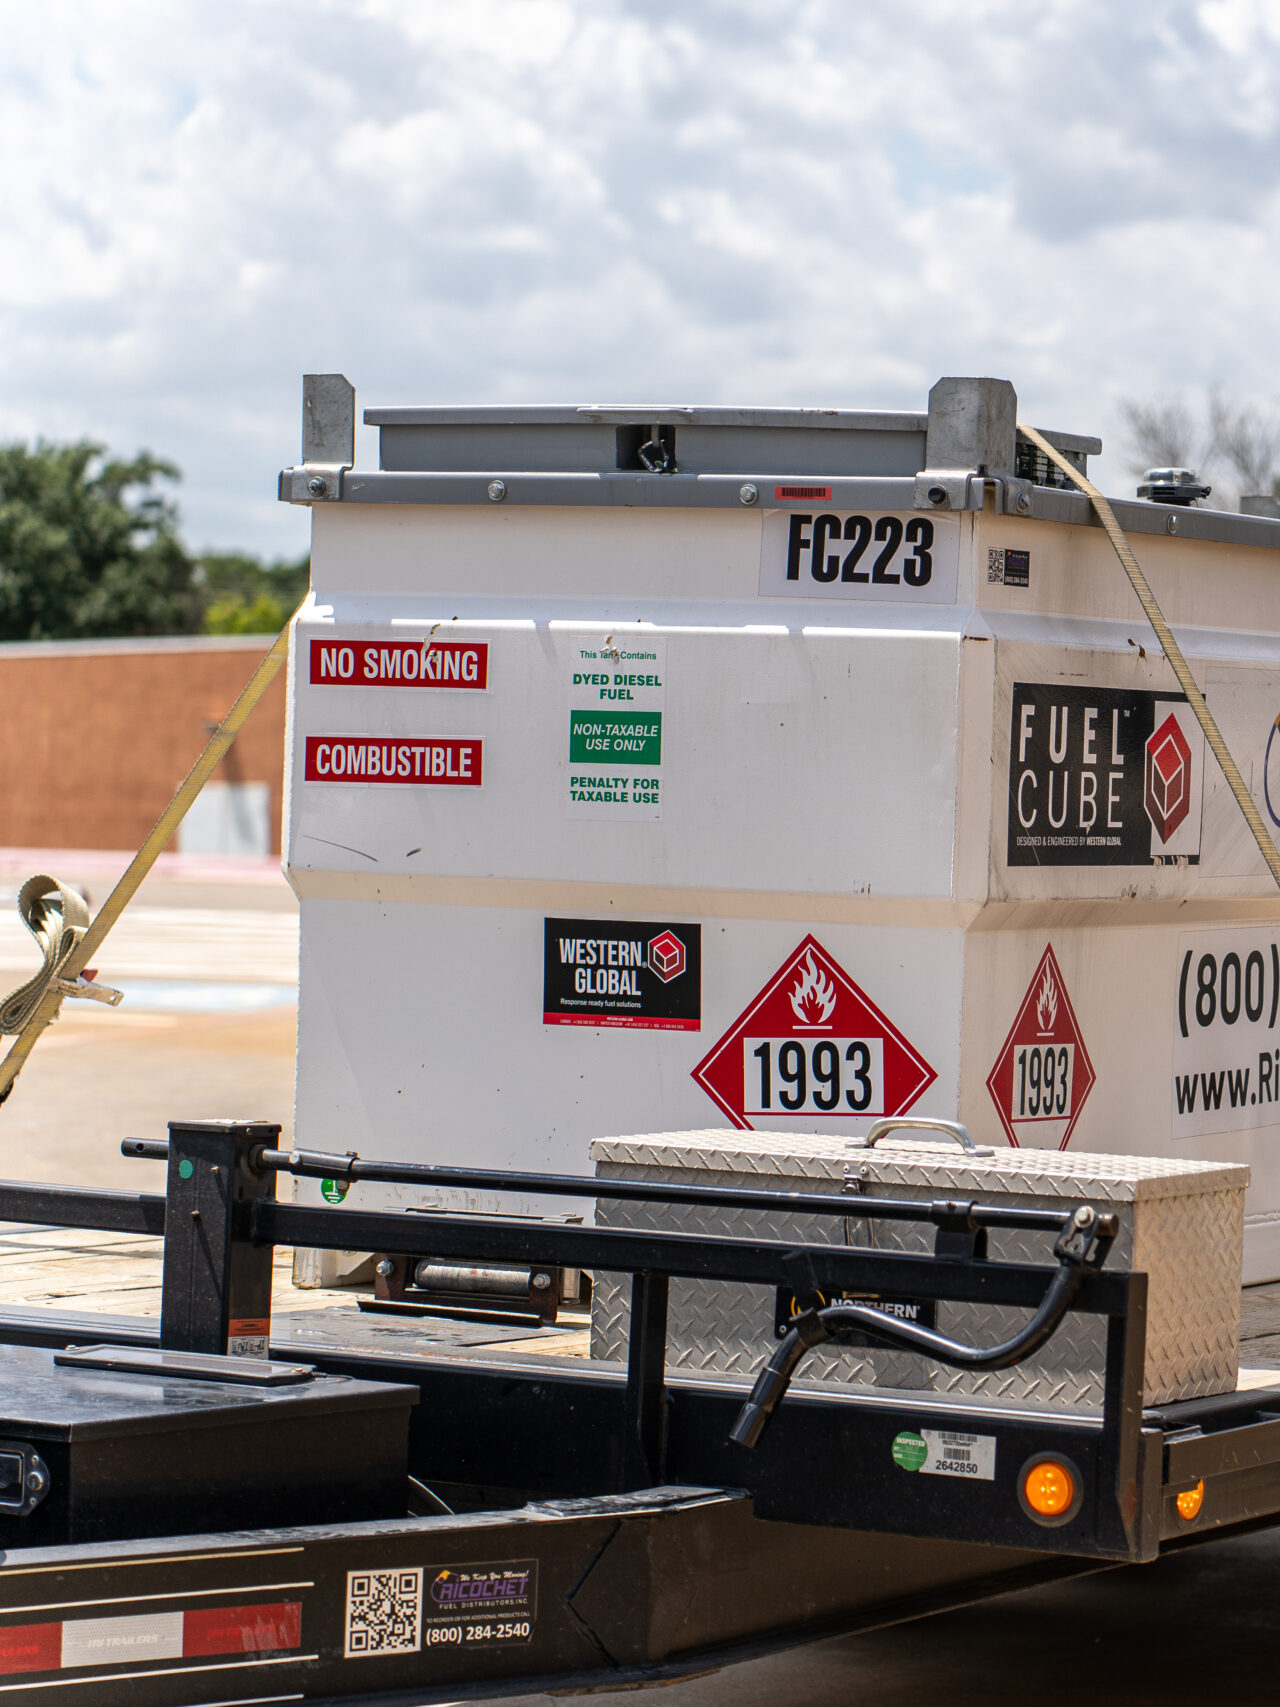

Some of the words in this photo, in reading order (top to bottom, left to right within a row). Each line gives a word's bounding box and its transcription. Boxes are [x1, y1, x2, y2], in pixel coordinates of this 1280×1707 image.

[786, 514, 934, 587] FC223
[320, 647, 355, 678] NO
[363, 648, 479, 681] SMOKING
[580, 650, 597, 659] This
[600, 650, 619, 660] Tan
[620, 651, 657, 660] Contains
[573, 673, 610, 685] DYED
[614, 674, 662, 687] DIESEL
[600, 688, 634, 700] FUEL
[573, 723, 659, 737] NON-TAXABLE
[1018, 704, 1125, 765] FUEL
[585, 738, 611, 750] USE
[613, 739, 646, 751] ONLY
[316, 744, 473, 778] COMBUSTIBLE
[570, 776, 629, 789] PENALTY
[632, 778, 660, 790] FOR
[569, 790, 629, 803] TAXABLE
[632, 792, 660, 804] USE
[1017, 769, 1124, 828] CUBE
[1016, 836, 1042, 846] DESIGNED
[559, 938, 642, 966] WESTERN
[574, 968, 642, 996] GLOBAL
[1178, 943, 1280, 1038] (800)
[561, 998, 587, 1007] Response
[588, 1000, 604, 1008] ready
[604, 1000, 616, 1008] fuel
[616, 1000, 642, 1009] solutions
[753, 1040, 873, 1112] 1993
[1018, 1045, 1068, 1117] 1993
[936, 1460, 978, 1474] 2642850
[440, 1578, 528, 1599] RICOCHET
[426, 1626, 463, 1646] (800)
[466, 1622, 530, 1641] 284-2540
